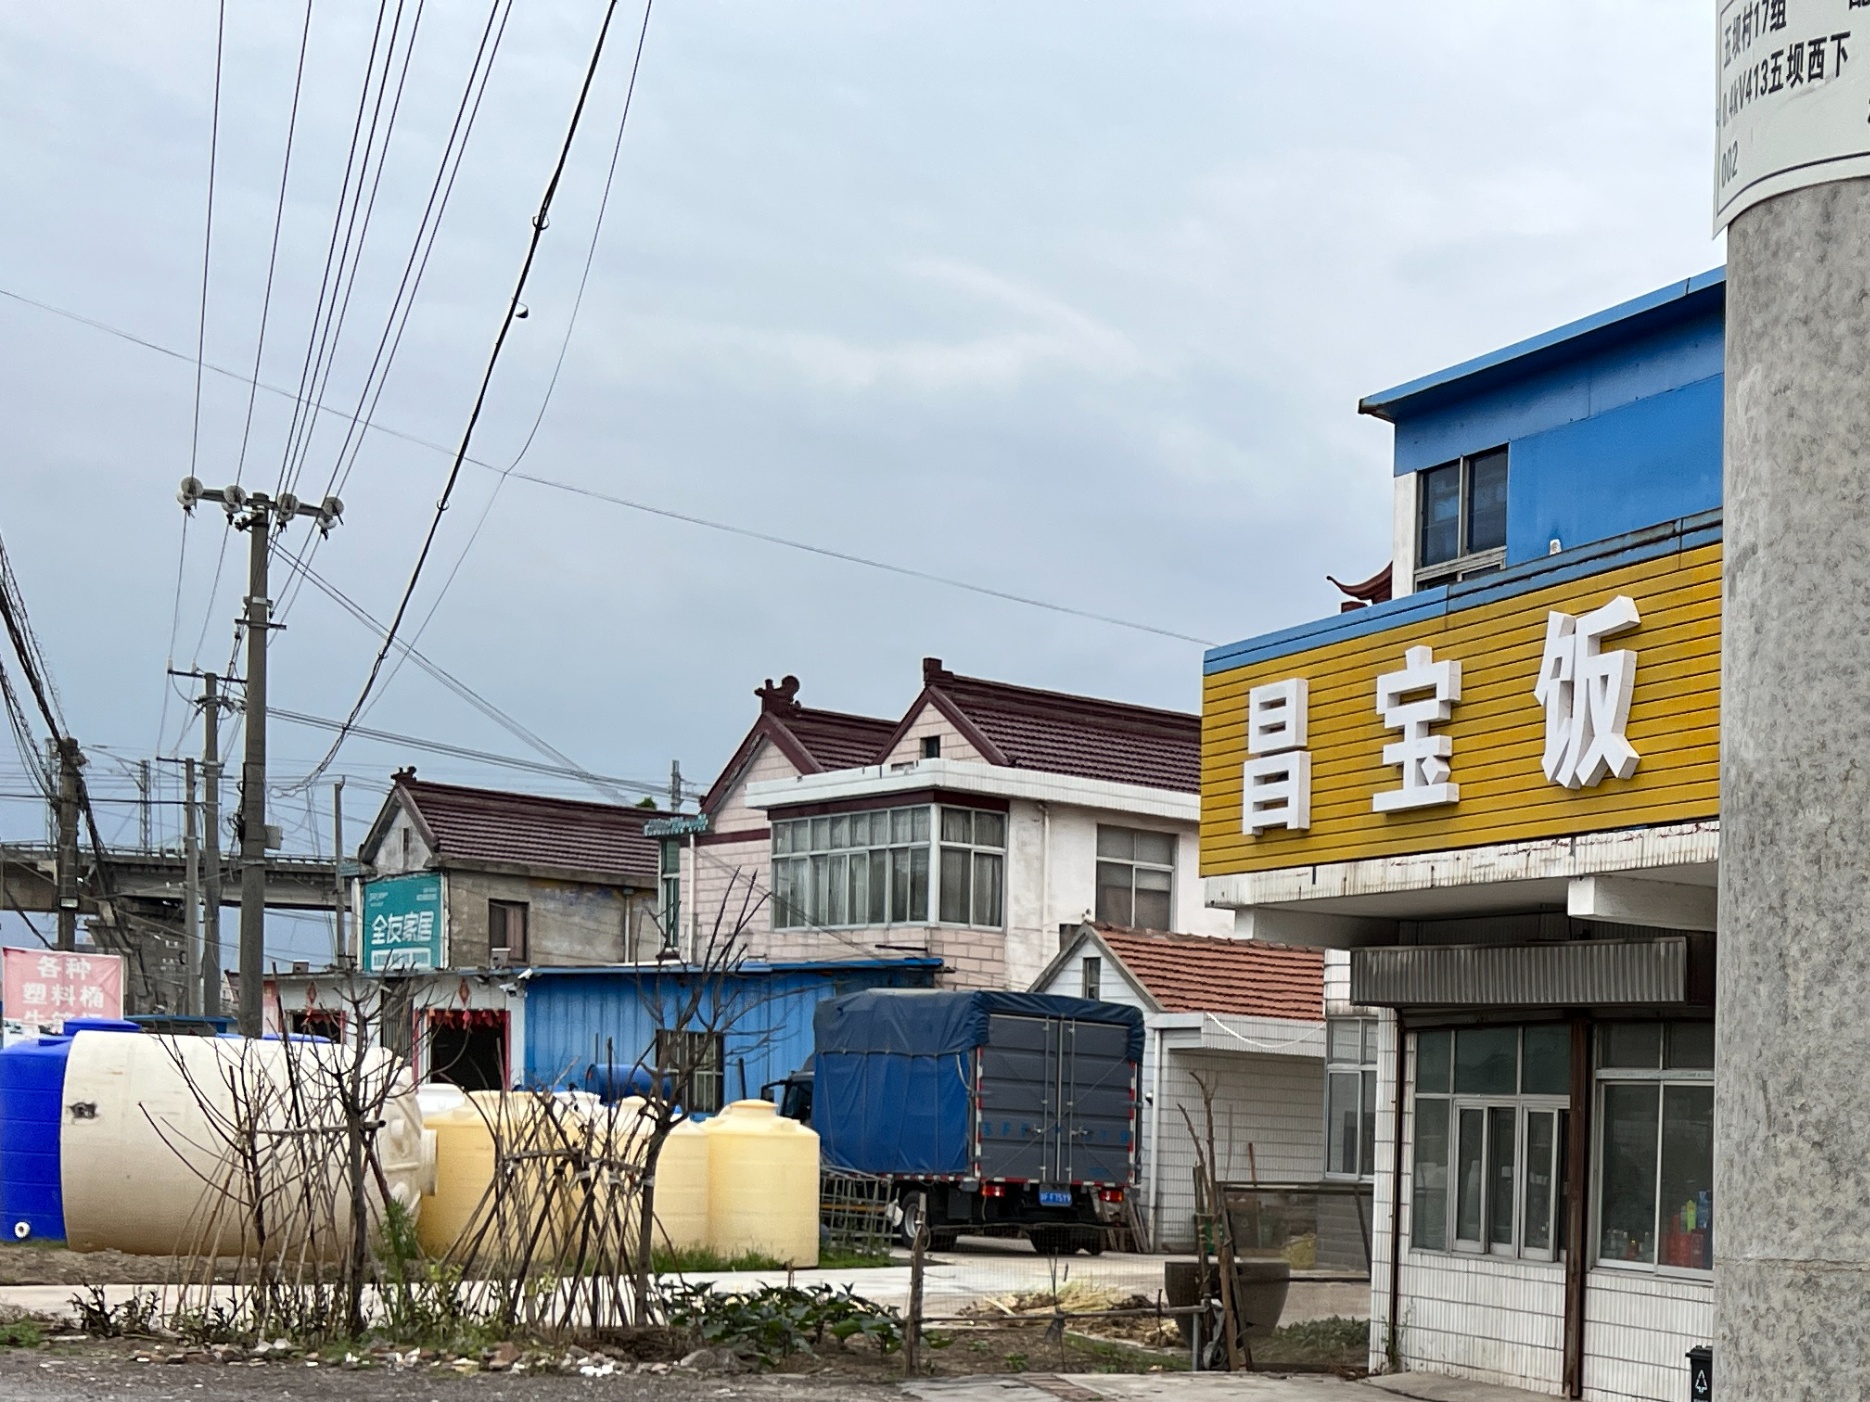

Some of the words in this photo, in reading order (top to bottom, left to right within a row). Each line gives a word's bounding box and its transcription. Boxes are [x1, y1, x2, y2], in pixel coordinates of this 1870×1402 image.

[1721, 140, 1739, 188] 002
[1242, 594, 1641, 836] 昌宝饭
[371, 910, 435, 945] 全友家居
[37, 955, 91, 980] 各种
[22, 982, 105, 1009] 塑料桶
